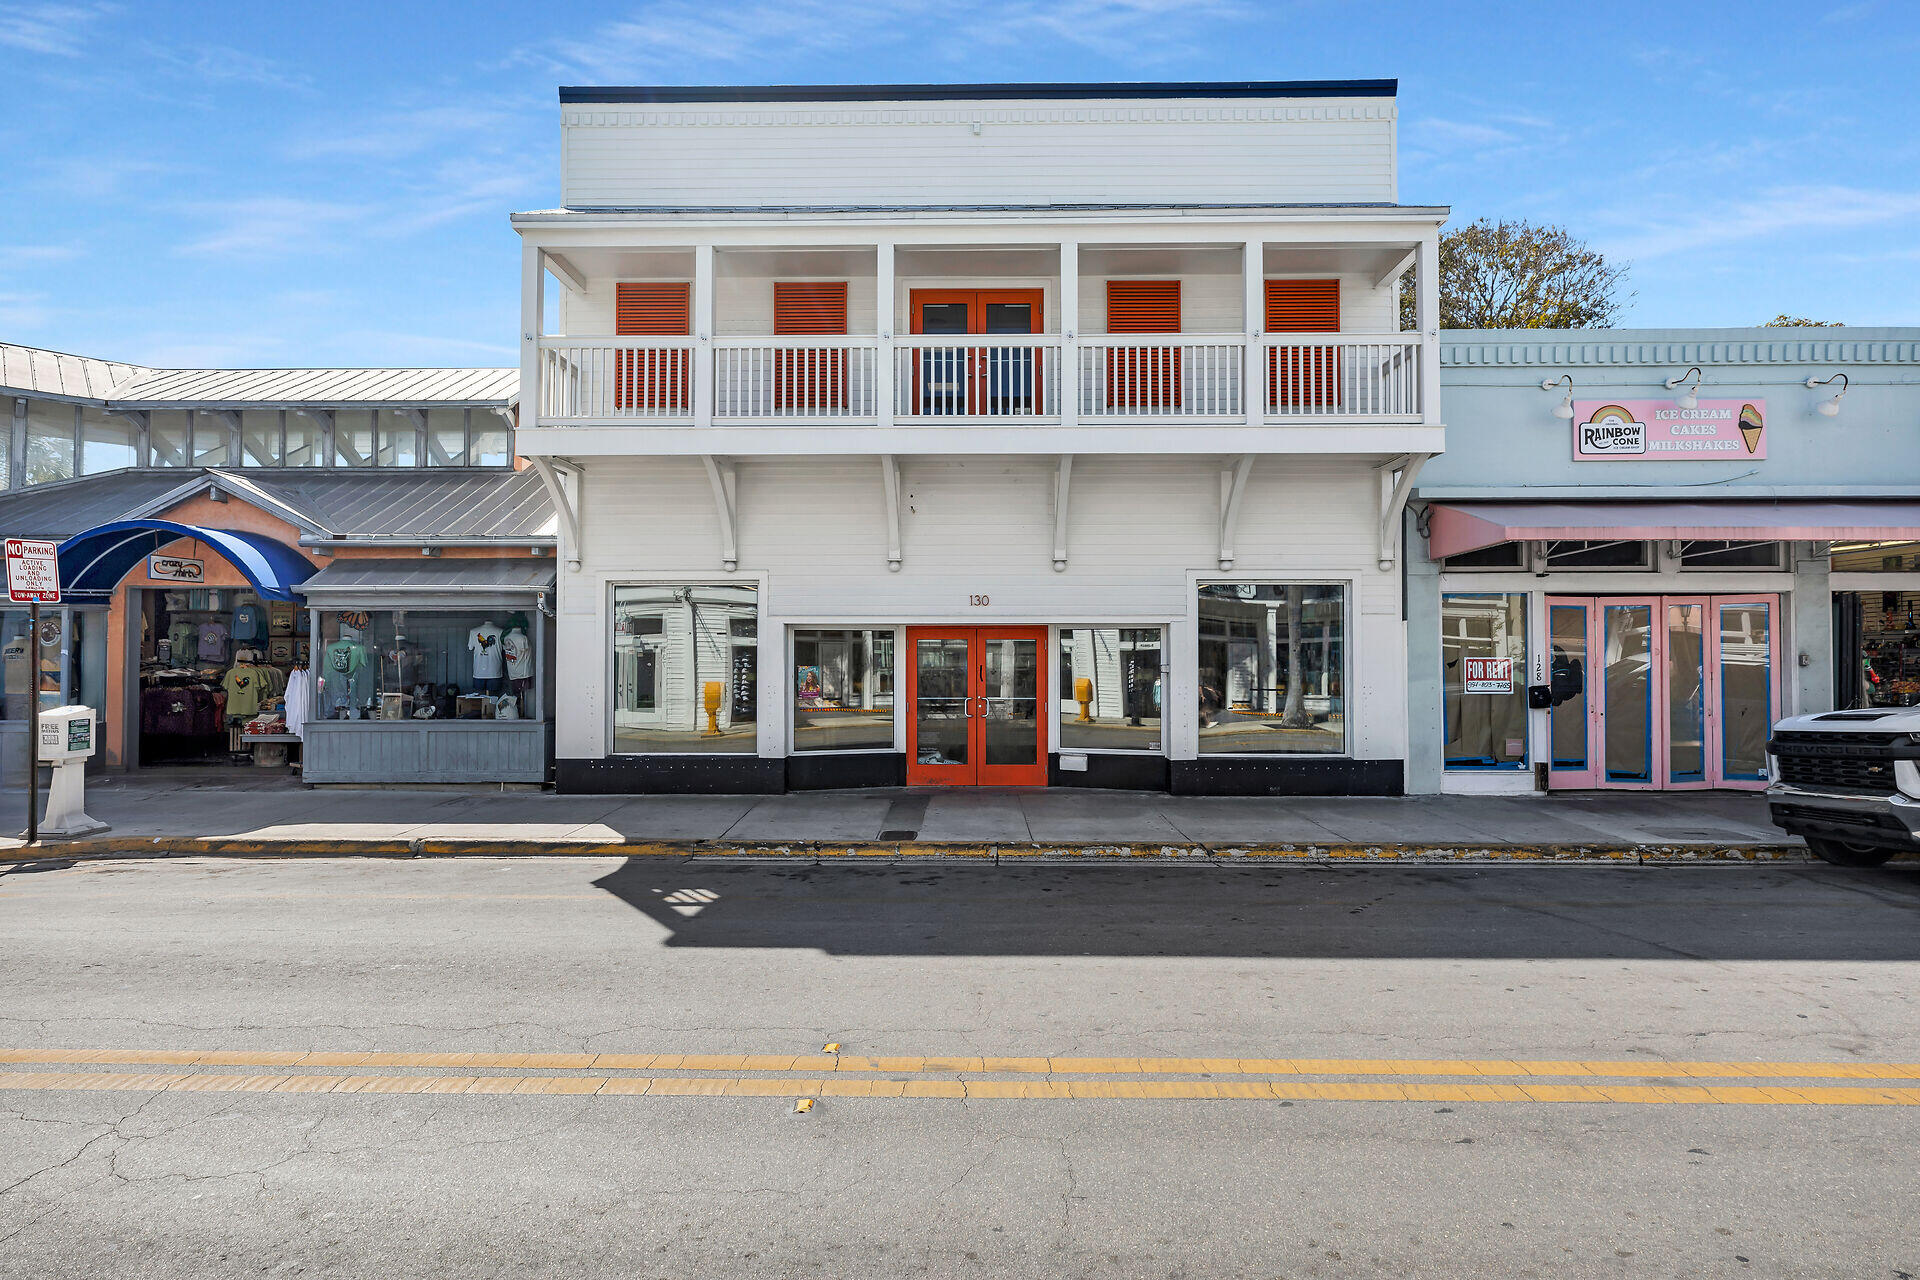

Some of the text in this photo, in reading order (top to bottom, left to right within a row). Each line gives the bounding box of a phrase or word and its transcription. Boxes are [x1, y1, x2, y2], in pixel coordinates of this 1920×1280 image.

[1655, 409, 1732, 420] ICE CREAM
[1670, 424, 1717, 435] CAKES
[1585, 427, 1640, 447] RAINBOW
[1612, 438, 1640, 446] CONE
[1648, 440, 1740, 451] MILKSHAKES
[8, 543, 54, 555] NO PARKING
[969, 594, 990, 607] 130
[1467, 660, 1509, 679] FOR RENT
[1776, 744, 1890, 756] CHEVROLET
